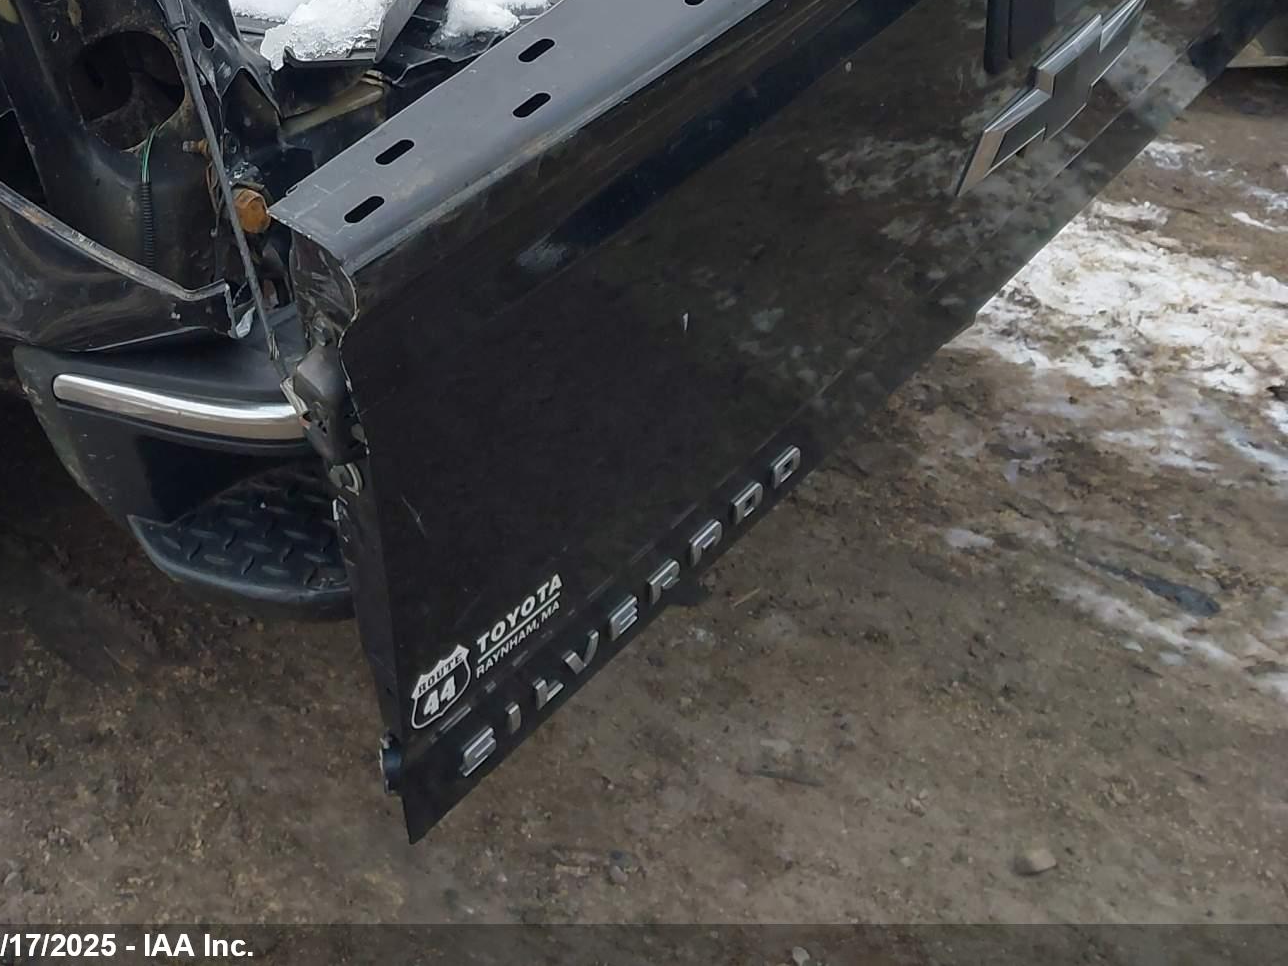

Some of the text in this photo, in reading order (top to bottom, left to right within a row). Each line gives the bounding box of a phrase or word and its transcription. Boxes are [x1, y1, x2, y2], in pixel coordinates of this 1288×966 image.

[459, 444, 801, 778] SILVERADO
[475, 600, 560, 679] RAYNHAM, MA
[476, 573, 563, 653] TOYOTA
[417, 652, 464, 695] ROUTE
[423, 674, 457, 716] 44
